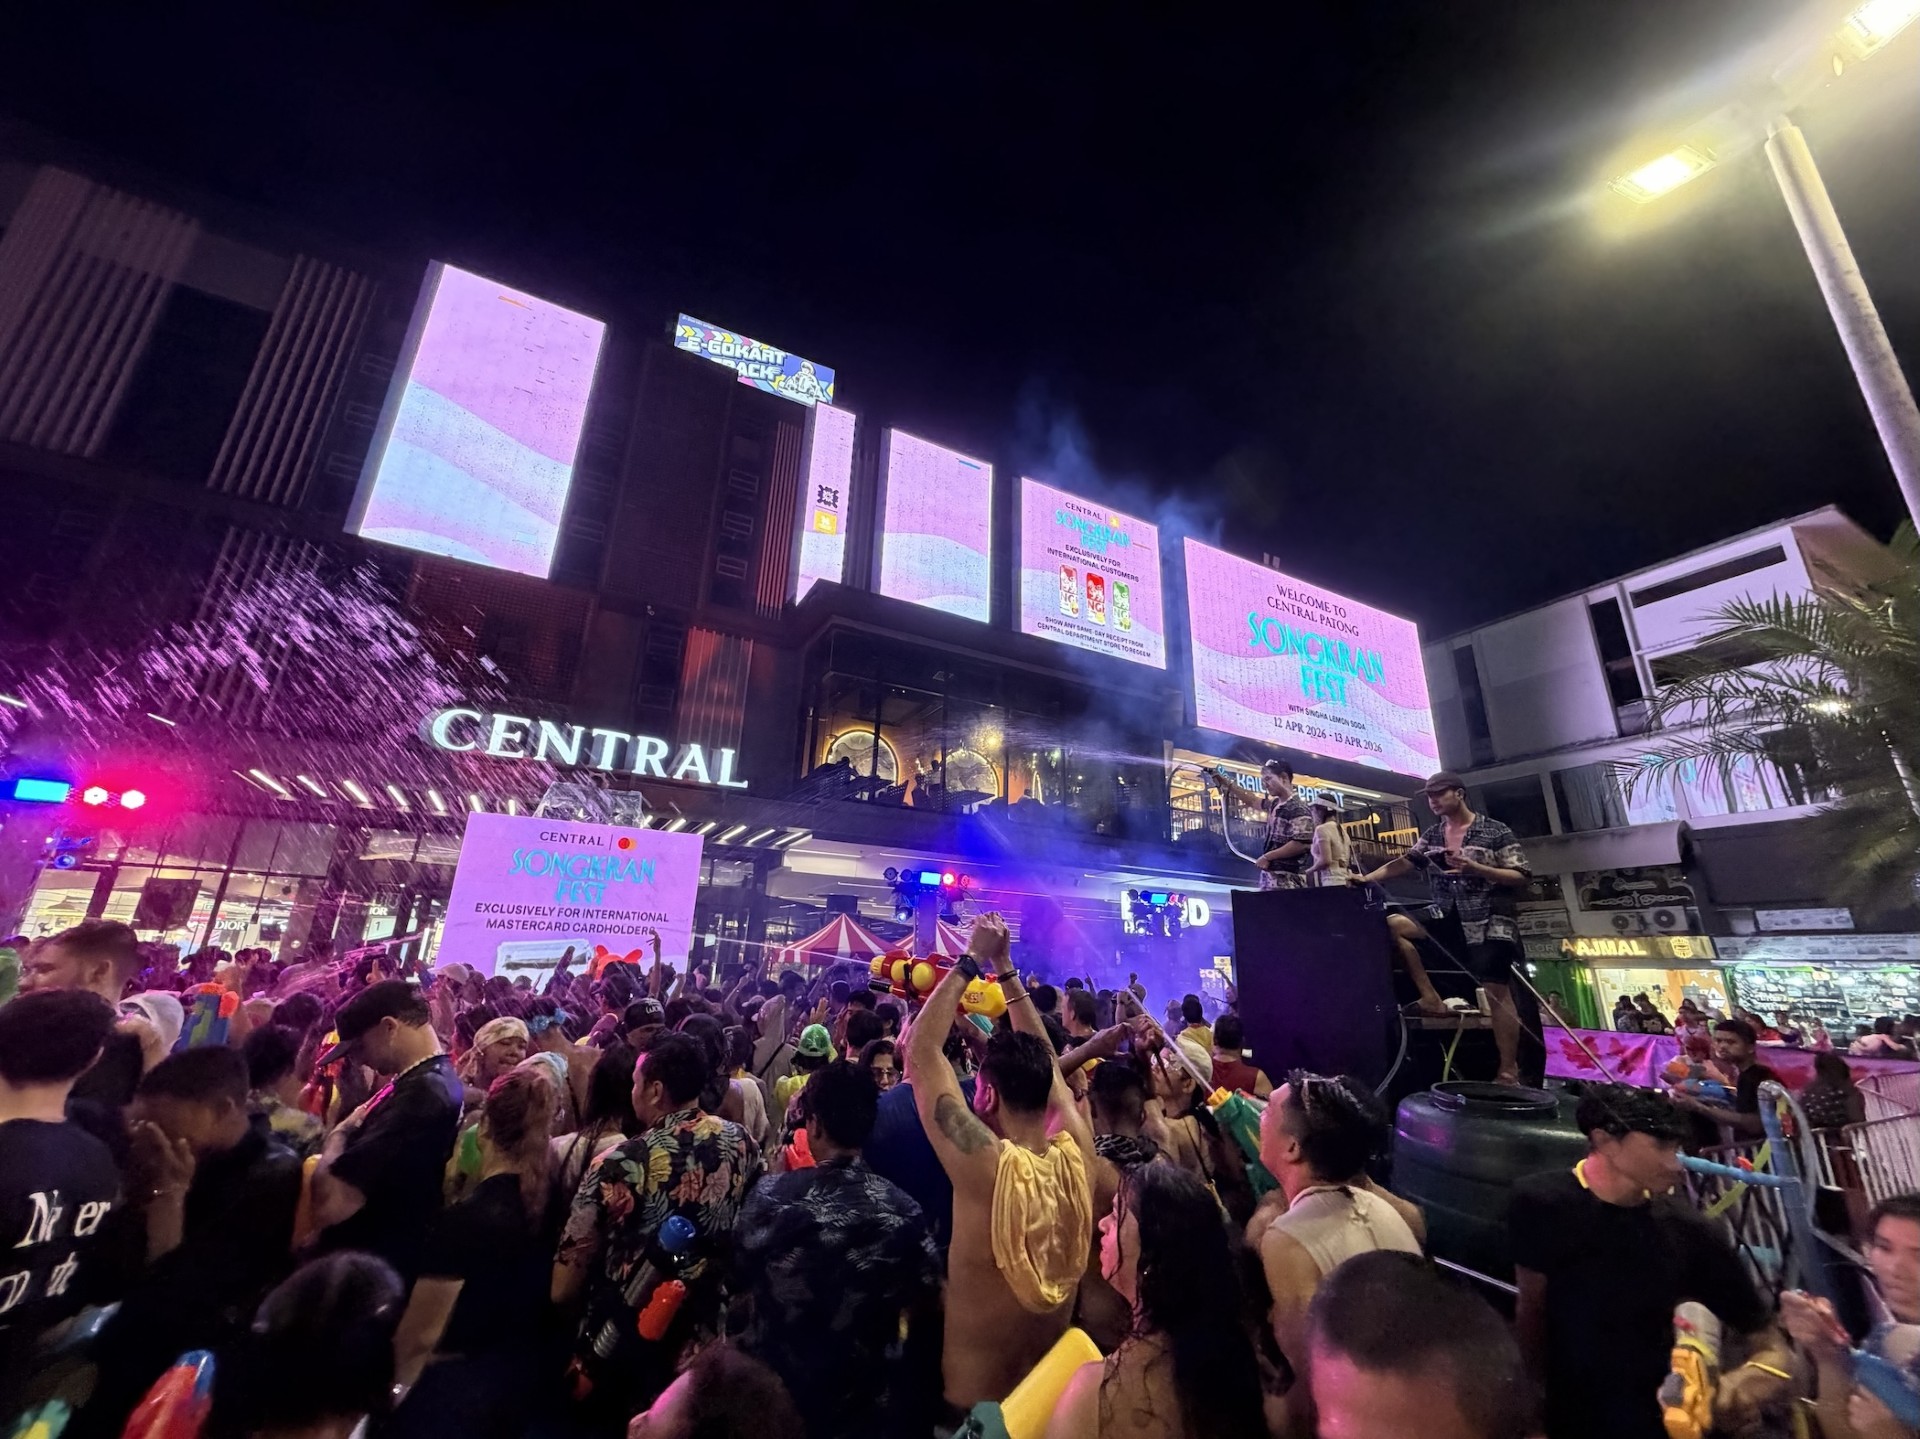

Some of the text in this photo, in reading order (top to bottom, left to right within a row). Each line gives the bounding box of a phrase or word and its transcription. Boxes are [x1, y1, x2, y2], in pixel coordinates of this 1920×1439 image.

[687, 336, 786, 366] E-GOKART
[1065, 502, 1102, 521] CENTRAL
[1055, 509, 1131, 547] SONGKRAN
[1047, 547, 1139, 582] INTERNATIONAL CUSTOMERS
[1065, 545, 1121, 568] EXCLUSIVELY FOR
[1276, 584, 1347, 618] WELCOME TO
[1267, 596, 1359, 637] CENTRAL PATONG
[1037, 622, 1064, 635] CENTRAL
[1065, 630, 1102, 645] DEPARTMENT
[1103, 640, 1120, 650] STORE
[1045, 616, 1063, 626] SHOW
[1064, 621, 1076, 630] ANY
[1106, 633, 1128, 643] RECEIPT
[1128, 640, 1144, 648] FROM
[1247, 611, 1386, 687] SONGKRAN
[1300, 665, 1348, 708] FEST
[1288, 704, 1366, 730] WITH SINGHA LEMON SODA
[432, 708, 748, 788] CENTRAL
[1273, 717, 1283, 728] 12
[1285, 720, 1304, 733] APR
[1306, 725, 1327, 739] 2026
[1334, 732, 1343, 743] 13
[1344, 736, 1362, 748] APR
[1363, 740, 1382, 753] 2026
[1236, 773, 1268, 793] KAIL
[540, 831, 604, 847] CENTRAL
[508, 848, 656, 883] SONGKRAN
[555, 879, 608, 904] FEST
[215, 920, 246, 931] DIOR
[369, 907, 388, 916] IOR
[475, 902, 669, 923] EXCLUSIVELY FOR INTERNATIONAL
[486, 918, 570, 932] MASTERCARD
